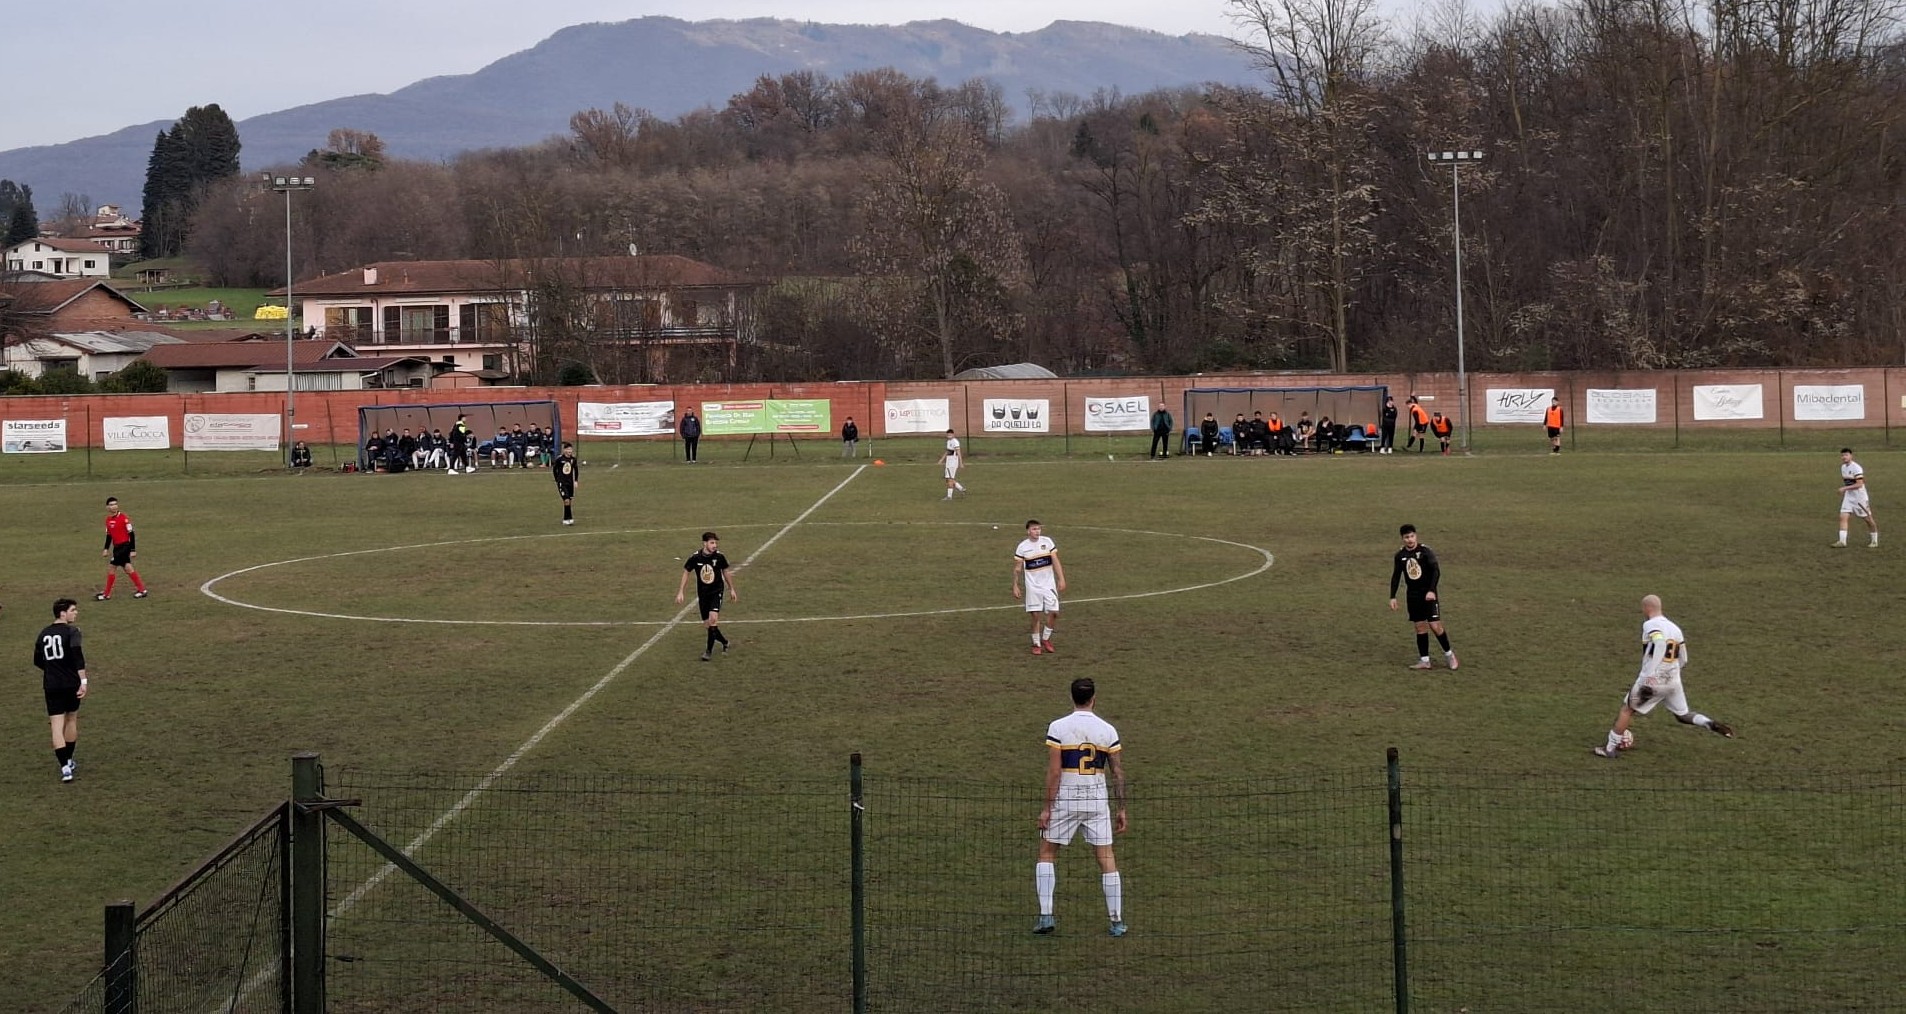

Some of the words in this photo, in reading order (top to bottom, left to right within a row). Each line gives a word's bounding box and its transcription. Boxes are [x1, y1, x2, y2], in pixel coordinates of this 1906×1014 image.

[1797, 392, 1861, 403] Mibadental
[1104, 401, 1147, 414] SAEL
[8, 421, 60, 430] starseeds
[43, 634, 64, 660] 20
[1078, 742, 1097, 775] 2
